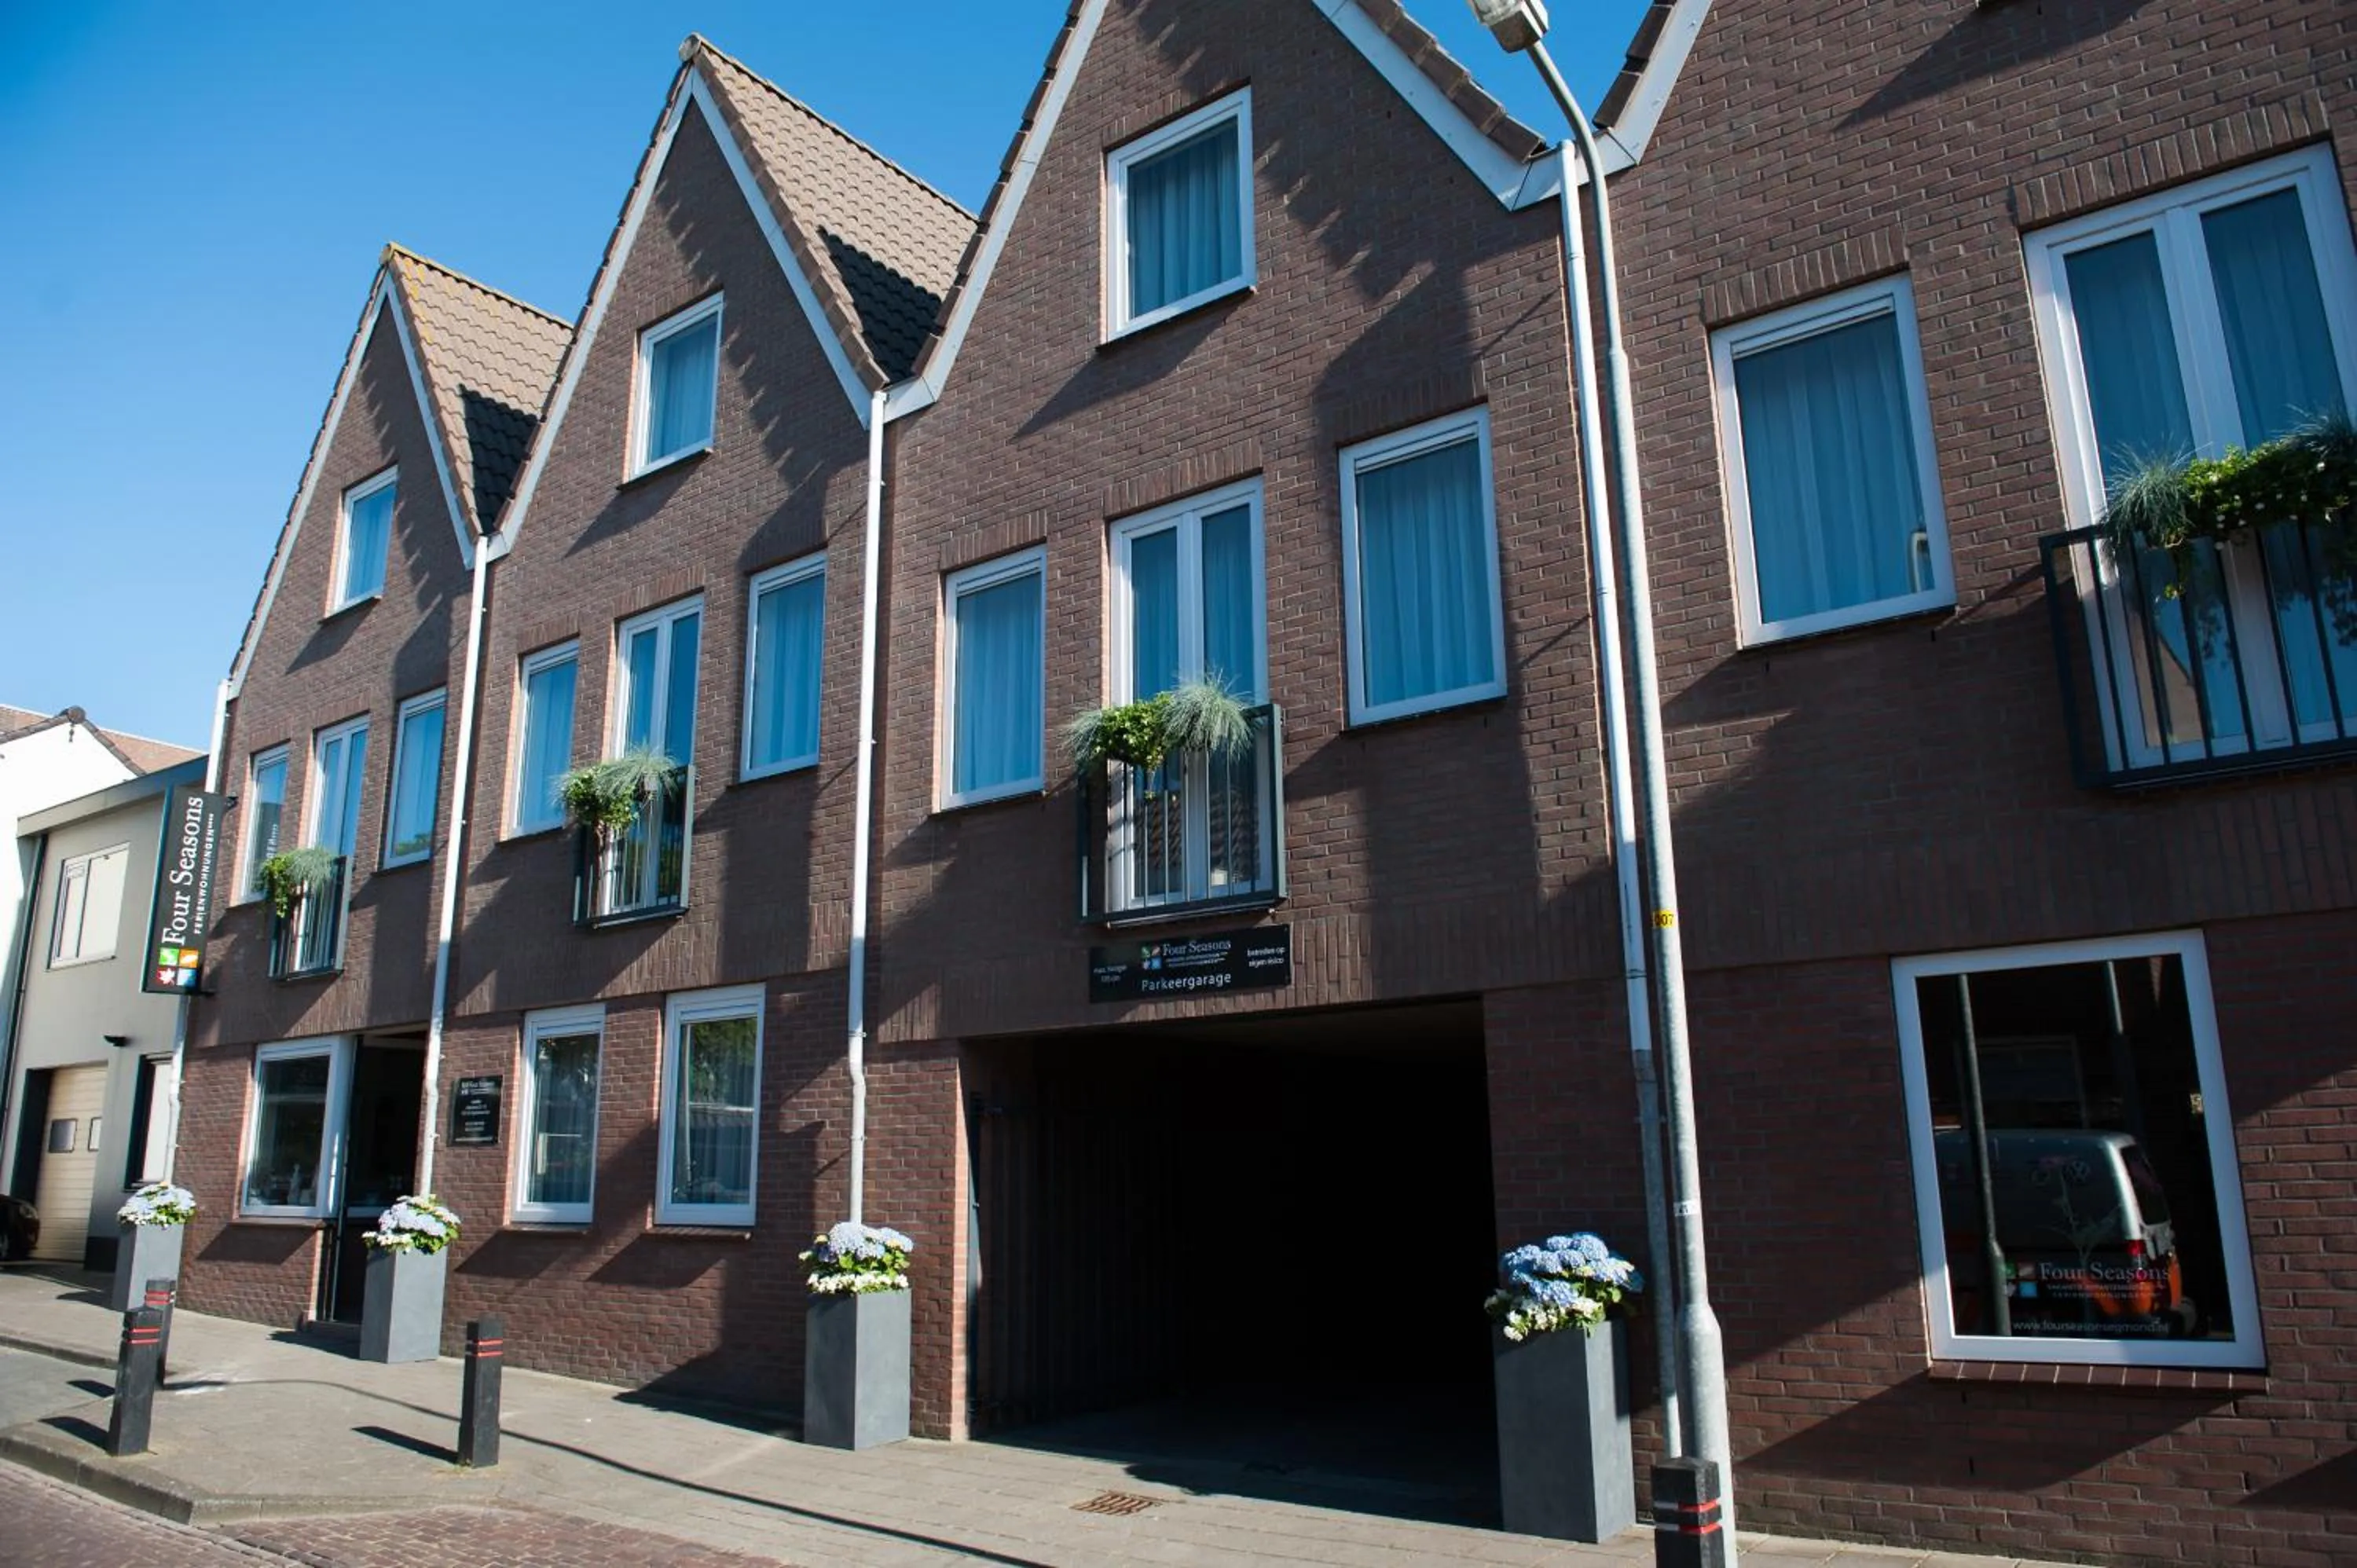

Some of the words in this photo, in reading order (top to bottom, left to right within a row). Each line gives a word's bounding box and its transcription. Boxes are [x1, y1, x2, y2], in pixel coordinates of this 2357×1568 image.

[170, 796, 203, 886] Seasons
[193, 829, 214, 935] FERIENWOHNUNGEN
[161, 890, 192, 946] Four
[1163, 943, 1188, 957] Four
[1189, 940, 1232, 953] Seasons
[1142, 973, 1232, 991] Parkeergarage
[2039, 1262, 2086, 1280] Four
[2090, 1261, 2170, 1282] Seasons
